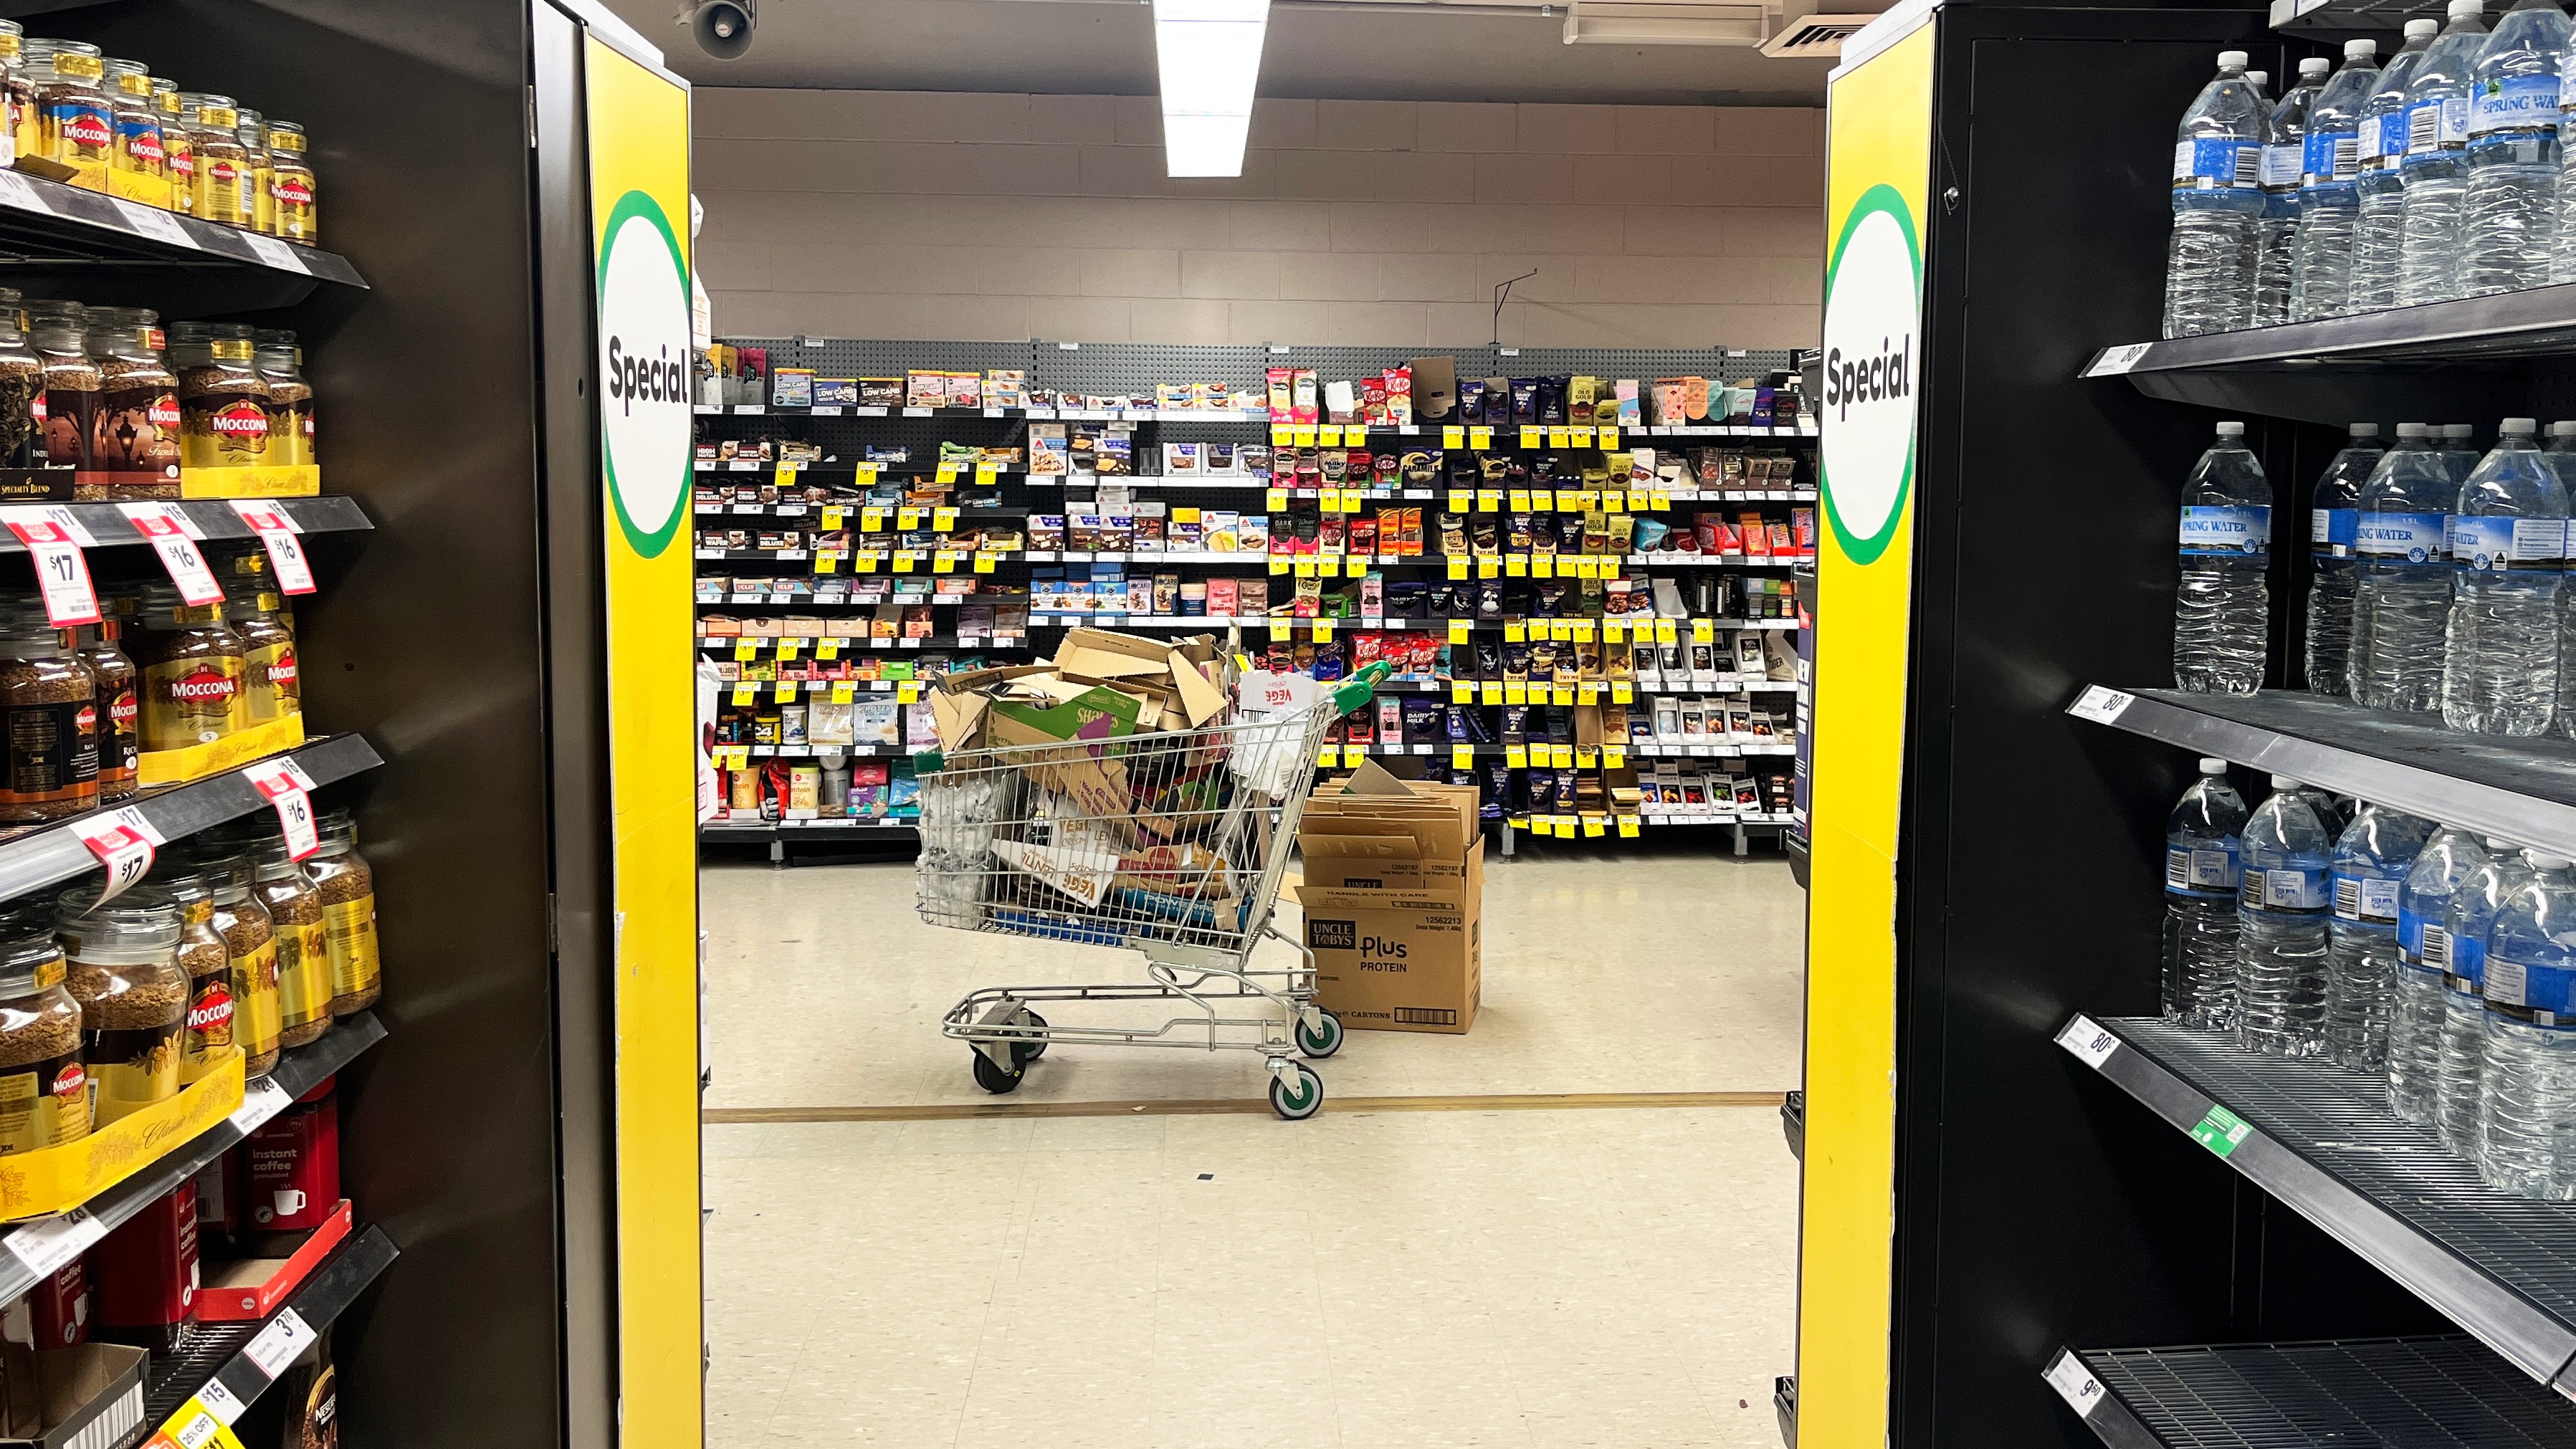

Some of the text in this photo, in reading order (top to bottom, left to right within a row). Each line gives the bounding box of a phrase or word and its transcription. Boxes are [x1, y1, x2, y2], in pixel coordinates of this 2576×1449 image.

[2484, 95, 2560, 115] SPRING WAT
[65, 125, 110, 143] MOCCONA
[130, 142, 163, 158] MOCCON
[210, 168, 236, 178] MOCCONA
[275, 188, 311, 202] MOCCONA
[609, 335, 687, 416] Special
[1827, 333, 1909, 421] Special
[863, 388, 879, 396] LOW
[1390, 378, 1411, 392] KitKat
[1367, 391, 1385, 402] KitKat
[149, 408, 180, 423] MOCCON
[214, 417, 267, 431] MOCCONA
[1, 479, 50, 494] SPECIALTY BLEND
[2182, 521, 2248, 533] SPRING WATER
[2375, 529, 2413, 541] WATER
[168, 545, 195, 568] $16
[274, 538, 295, 560] $16
[49, 555, 73, 581] $17
[1356, 644, 1380, 655] KitKat
[1411, 651, 1435, 664] KitKat
[268, 666, 295, 681] MOCCO
[173, 681, 234, 697] MOCCONA
[1265, 689, 1292, 702] VEGE
[111, 704, 138, 719] MOCCON
[123, 747, 138, 756] RICH
[117, 808, 143, 826] $17
[287, 800, 306, 823] $16
[121, 855, 144, 884] $17
[1062, 873, 1097, 901] VEGE
[1144, 894, 1215, 914] POWERAD
[1313, 923, 1352, 934] UNCLE
[1313, 934, 1352, 946] TOBYS
[1360, 936, 1408, 959] Plus
[1360, 961, 1407, 972] PROTEIN
[211, 984, 218, 993] DE
[252, 1148, 297, 1159] instant
[253, 1160, 292, 1171] coffee
[201, 1382, 226, 1403] $15
[194, 1416, 212, 1434] OFF
